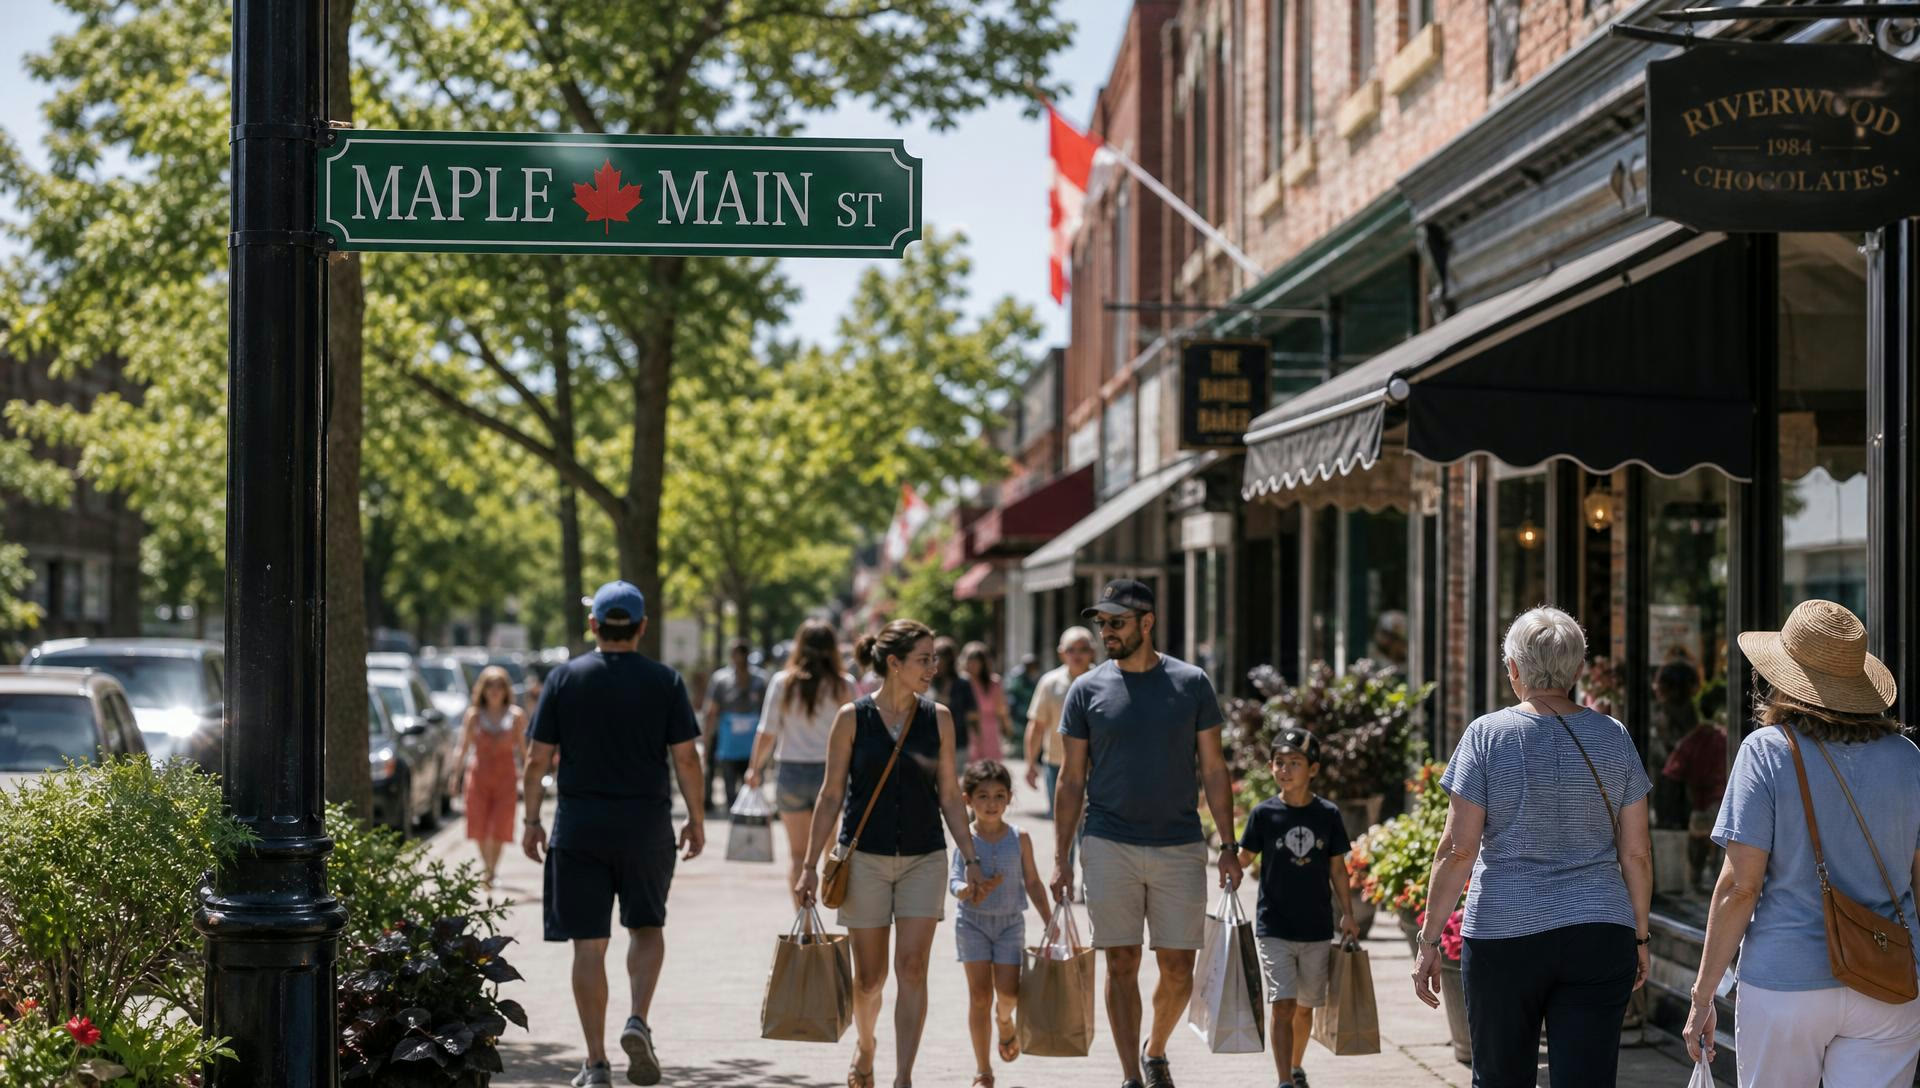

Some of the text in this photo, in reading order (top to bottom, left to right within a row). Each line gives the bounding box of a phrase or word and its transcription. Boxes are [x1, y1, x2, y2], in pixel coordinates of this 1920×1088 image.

[1682, 87, 1900, 137] RIVERWOOD
[1767, 139, 1813, 156] 1984
[351, 164, 883, 228] MAPLE MAIN ST
[1693, 165, 1889, 192] CHOCOLATES
